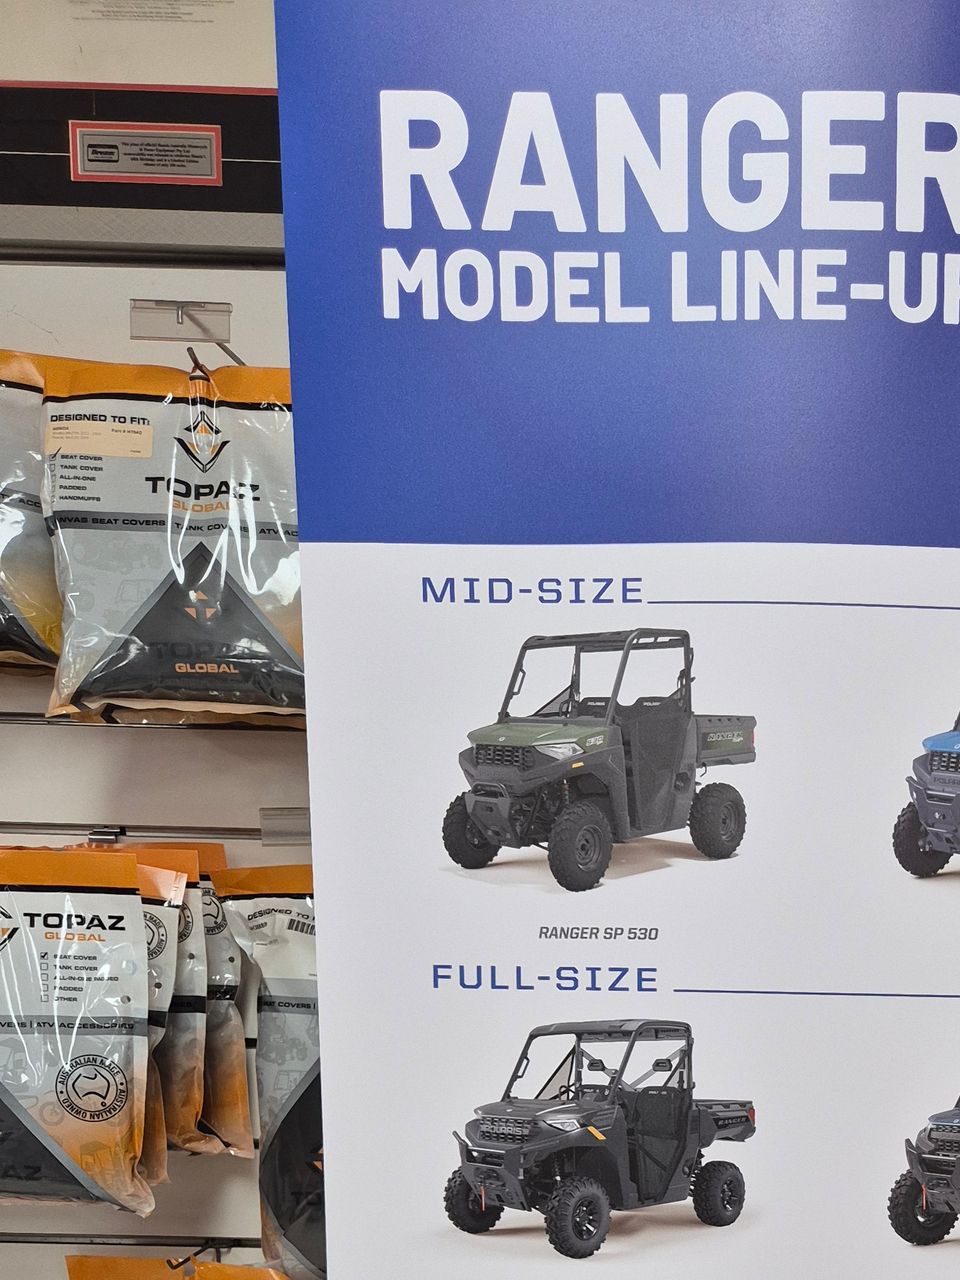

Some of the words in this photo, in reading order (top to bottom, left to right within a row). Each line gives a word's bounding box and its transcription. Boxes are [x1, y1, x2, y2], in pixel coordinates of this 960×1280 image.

[381, 248, 650, 323] MODEL
[50, 413, 107, 422] DESIGNED
[111, 415, 126, 424] TO
[130, 417, 150, 426] FIT:
[145, 476, 261, 502] TOPAZ
[122, 519, 166, 527] COVERS
[421, 576, 644, 604] MID-SIZE
[174, 662, 240, 674] GLOBAL
[247, 908, 292, 921] DESIGNED
[296, 911, 310, 920] TO
[23, 912, 126, 931] TOPAZ
[44, 932, 106, 942] GLOBAL
[538, 926, 600, 940] RANGER
[603, 926, 624, 940] SP
[627, 927, 658, 940] 530
[432, 964, 658, 992] FULL-SIZE
[278, 1001, 312, 1009] COVERS
